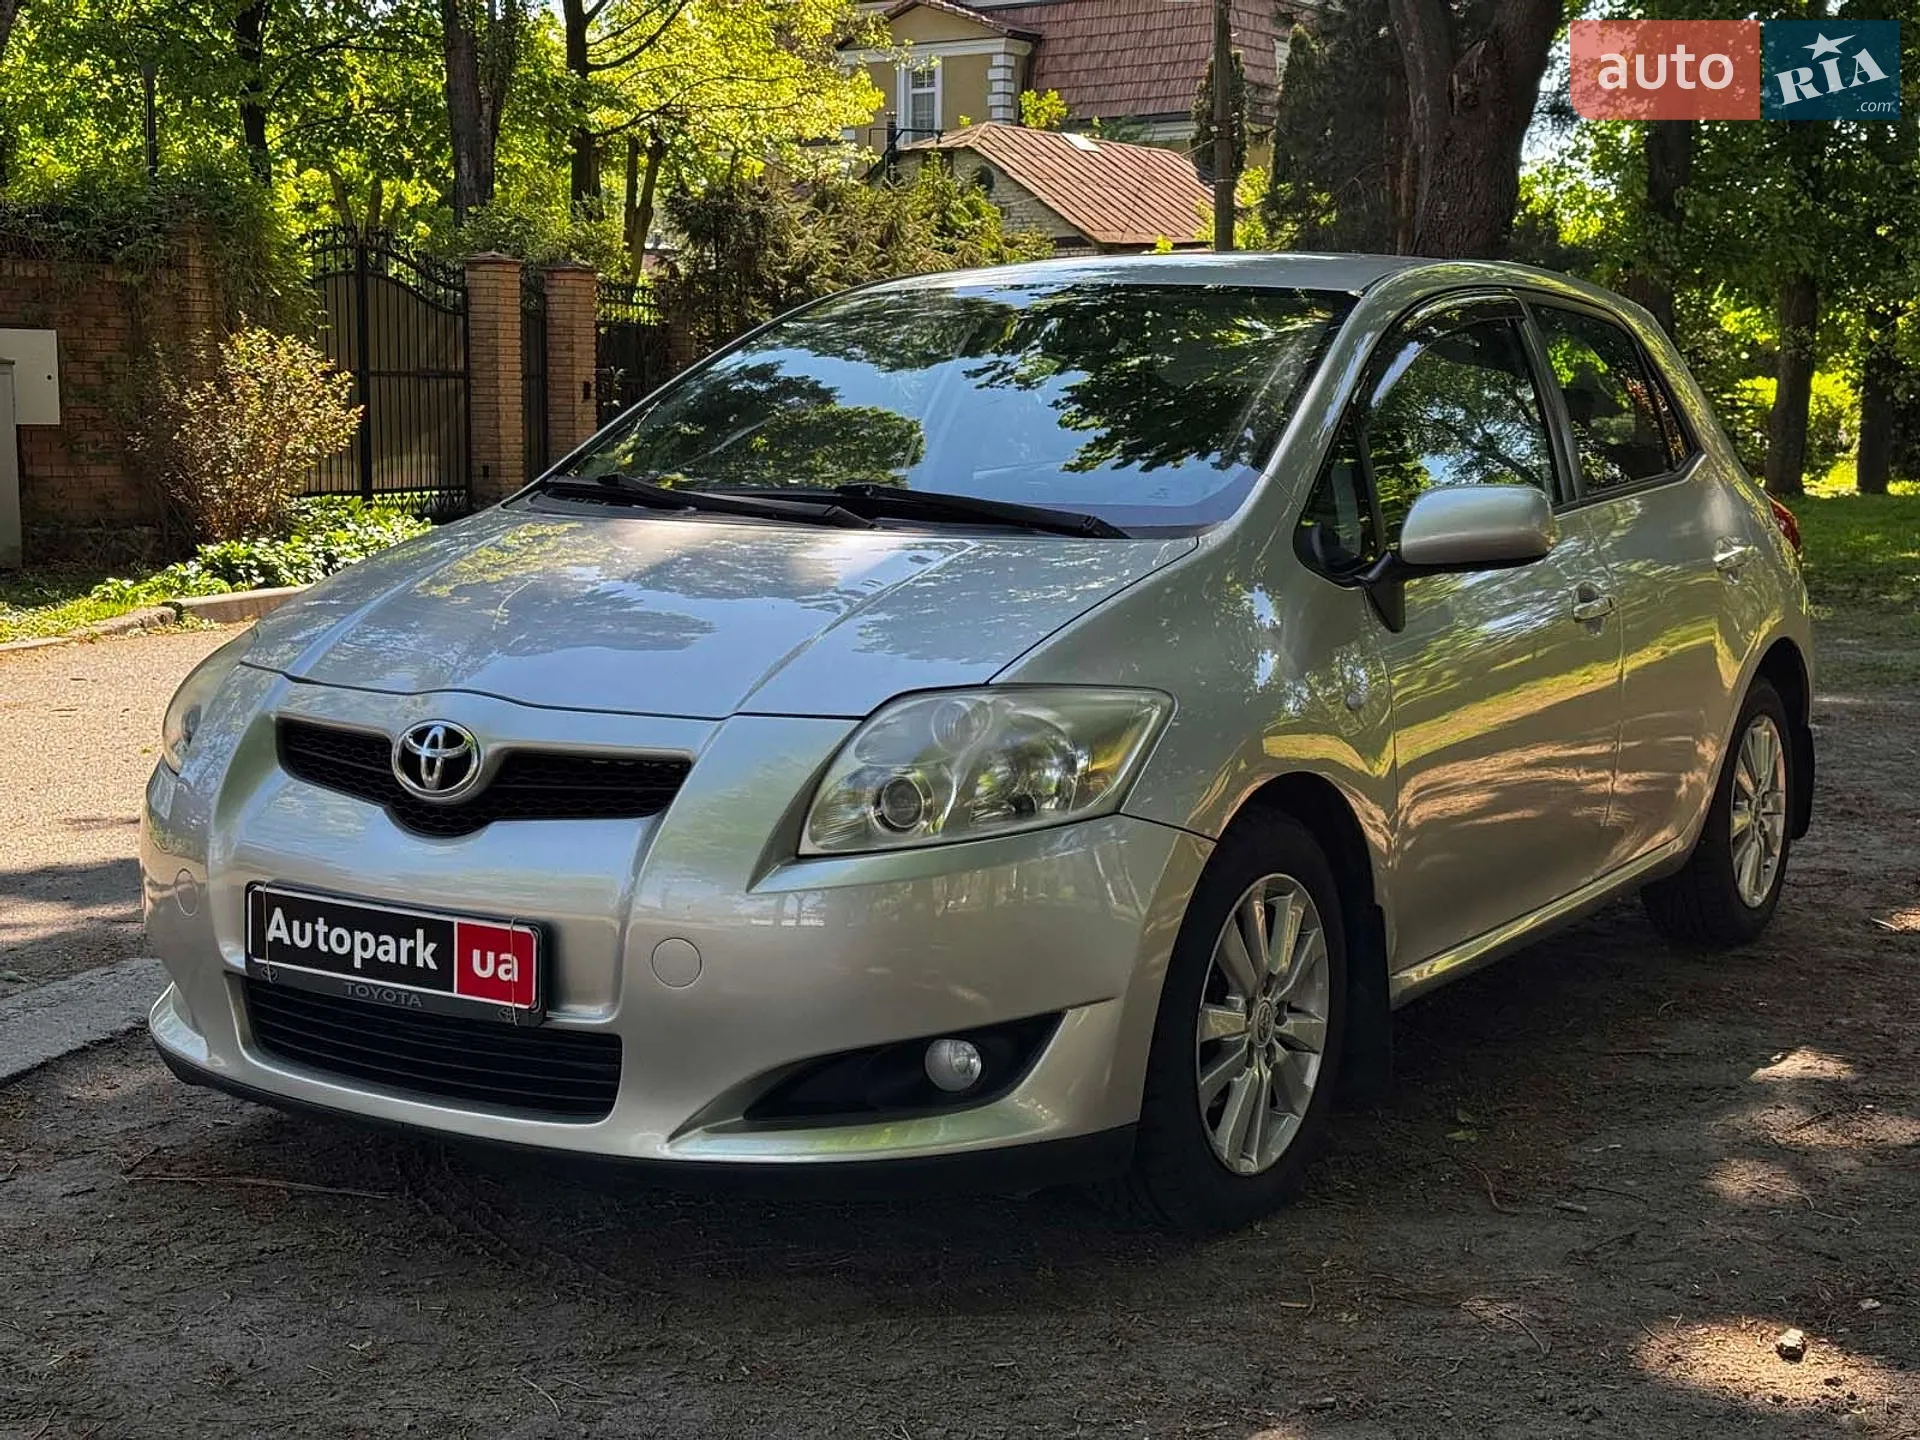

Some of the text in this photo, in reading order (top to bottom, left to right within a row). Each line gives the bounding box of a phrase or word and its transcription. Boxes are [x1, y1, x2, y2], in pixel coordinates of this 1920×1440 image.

[267, 906, 518, 982] Autopark ua
[344, 982, 422, 1007] TOYOTA
